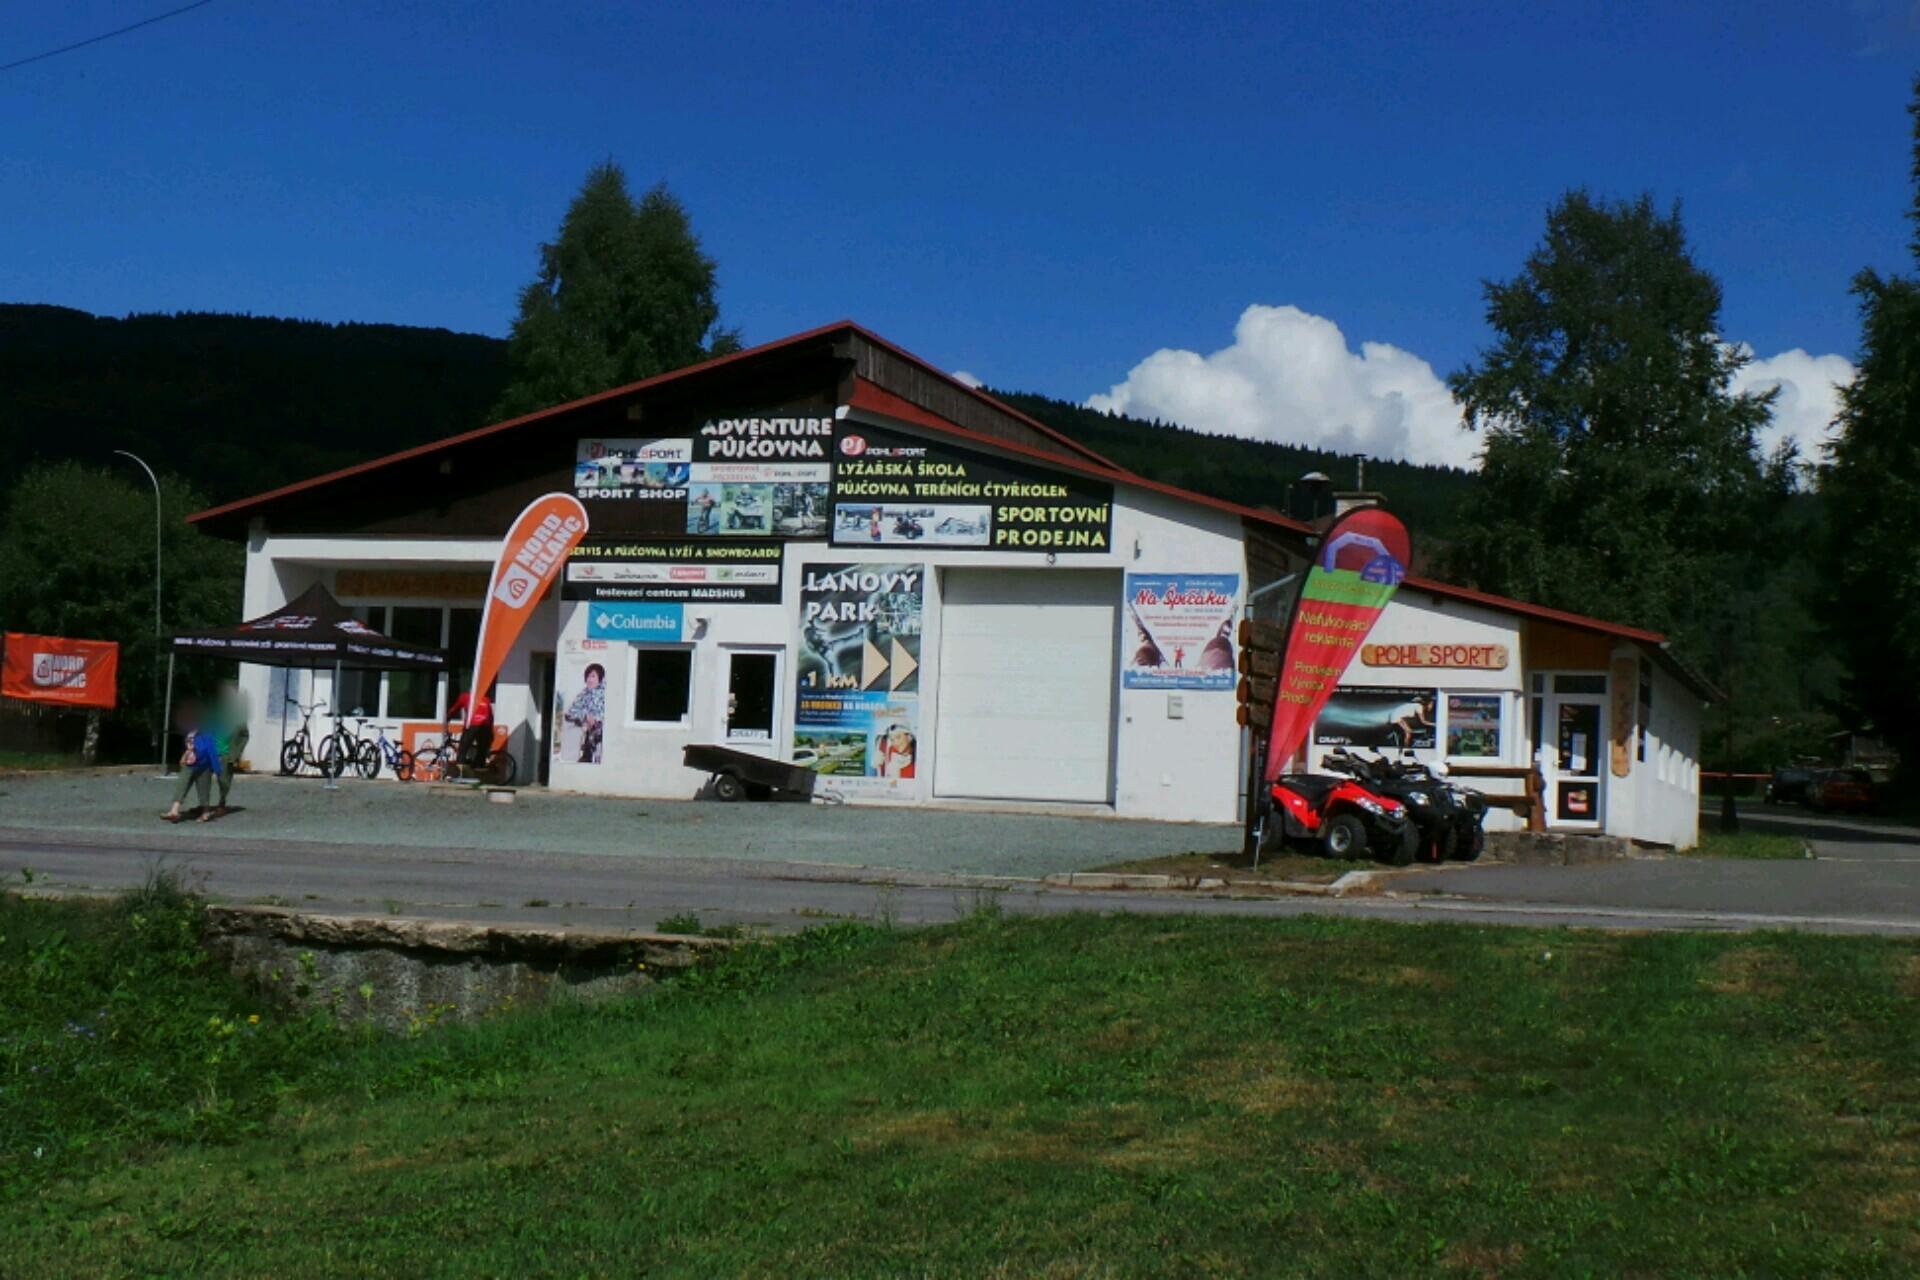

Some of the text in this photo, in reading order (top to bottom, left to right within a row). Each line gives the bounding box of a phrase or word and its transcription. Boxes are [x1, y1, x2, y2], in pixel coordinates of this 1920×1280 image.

[701, 418, 832, 435] ADVENTURE
[708, 435, 824, 458] PŮJČOVNA
[837, 460, 966, 477] LYŽAŘSKÁ ŠKOLA
[577, 489, 686, 499] SPORT SHOP
[837, 480, 909, 497] PŮJČOVNA
[983, 482, 1068, 497] ČTYŘKOLEK
[997, 503, 1109, 523] SPORTOVNÍ
[515, 513, 562, 566] NORD
[530, 516, 581, 577] BLANC
[996, 529, 1106, 547] PRODEJNA
[604, 547, 612, 556] A
[695, 547, 703, 557] A
[807, 568, 918, 592] LANOVÝ
[807, 601, 874, 621] PARK
[612, 613, 676, 629] Columbia
[1376, 645, 1494, 665] POHL SPORT
